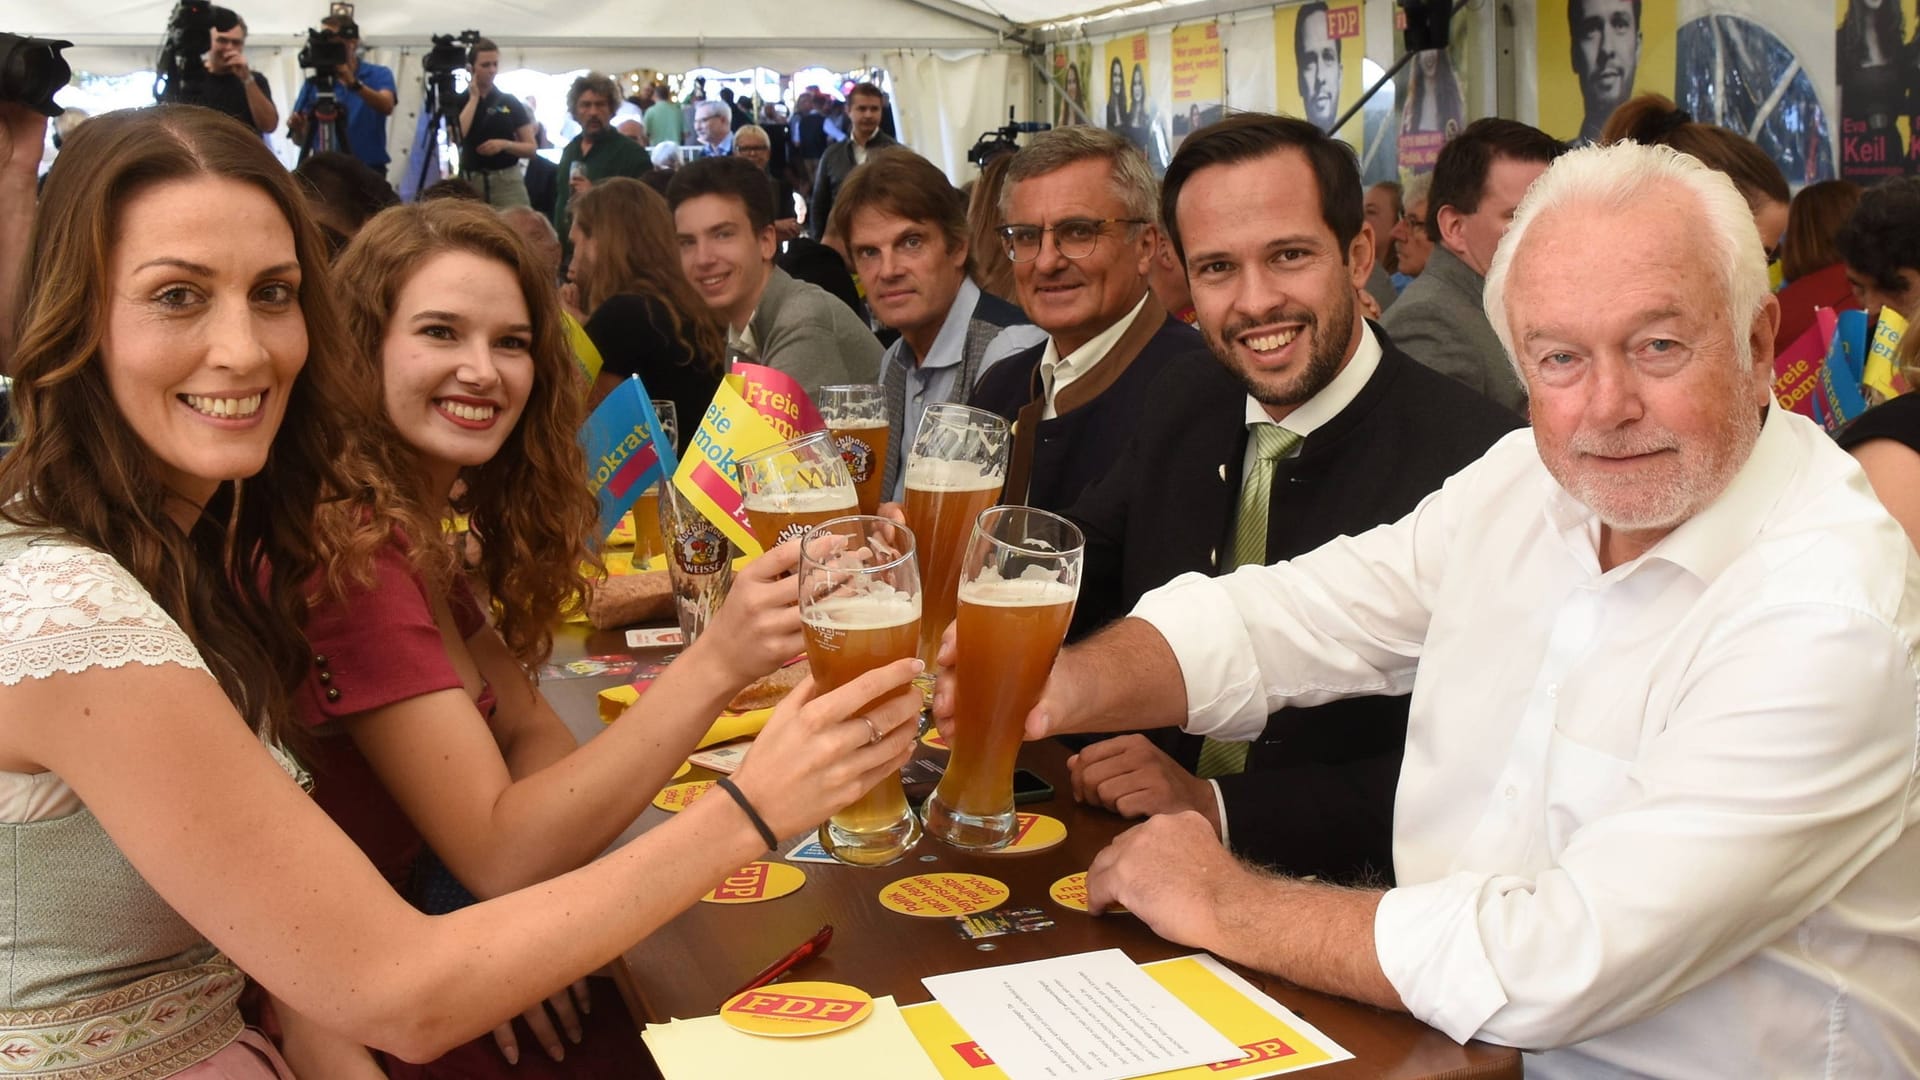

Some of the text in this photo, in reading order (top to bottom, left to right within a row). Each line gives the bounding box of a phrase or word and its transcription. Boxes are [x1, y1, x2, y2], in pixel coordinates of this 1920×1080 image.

[1327, 10, 1358, 37] FDP
[1843, 117, 1867, 133] Eva
[1844, 135, 1886, 162] Keil
[745, 381, 800, 420] Freie
[676, 522, 725, 545] Kuchlbauer
[683, 560, 721, 574] WEISSE
[721, 865, 762, 897] FDP
[887, 890, 924, 913] Politik
[913, 875, 977, 913] bayerischen
[739, 994, 853, 1018] FDP
